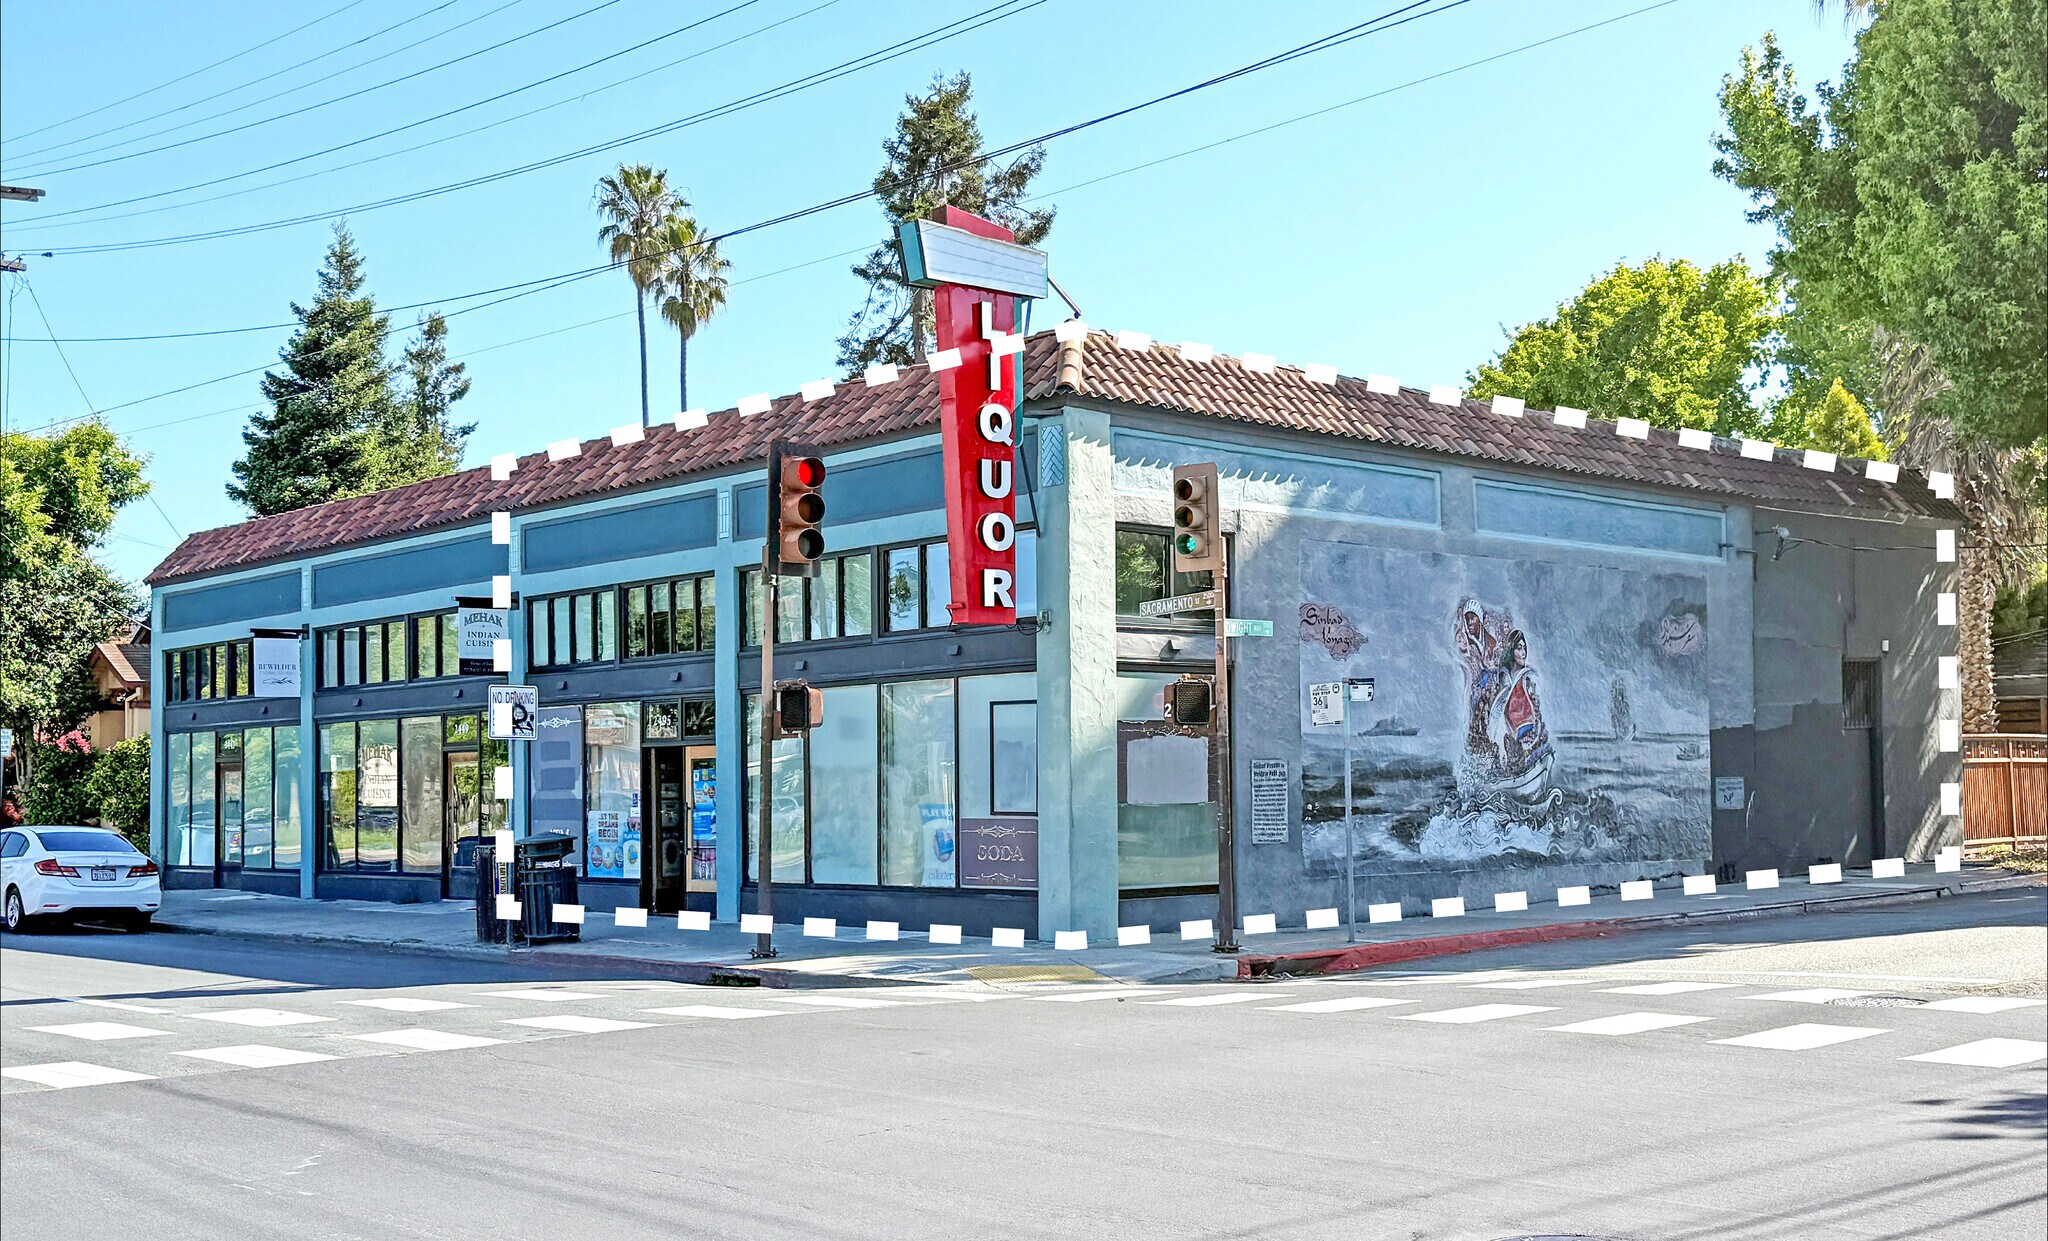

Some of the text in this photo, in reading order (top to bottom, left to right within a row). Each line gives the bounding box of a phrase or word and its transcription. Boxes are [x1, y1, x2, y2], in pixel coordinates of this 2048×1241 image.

[980, 301, 1016, 608] LIQUOR
[1141, 596, 1200, 616] SACRAMENTO ST
[464, 612, 502, 628] MEHAK
[1301, 607, 1343, 626] Sinbad
[1226, 621, 1253, 634] DWIGHT
[467, 631, 500, 639] INDIAN
[465, 639, 494, 647] CUISIN
[258, 663, 297, 671] BEWILDER
[493, 691, 534, 704] NO DRINKING
[1313, 697, 1323, 706] 36
[1163, 703, 1172, 718] 2
[362, 743, 393, 766] MEHAK
[363, 788, 392, 799] CUISINE
[598, 829, 619, 838] BEGIN
[977, 845, 1026, 862] SODA
